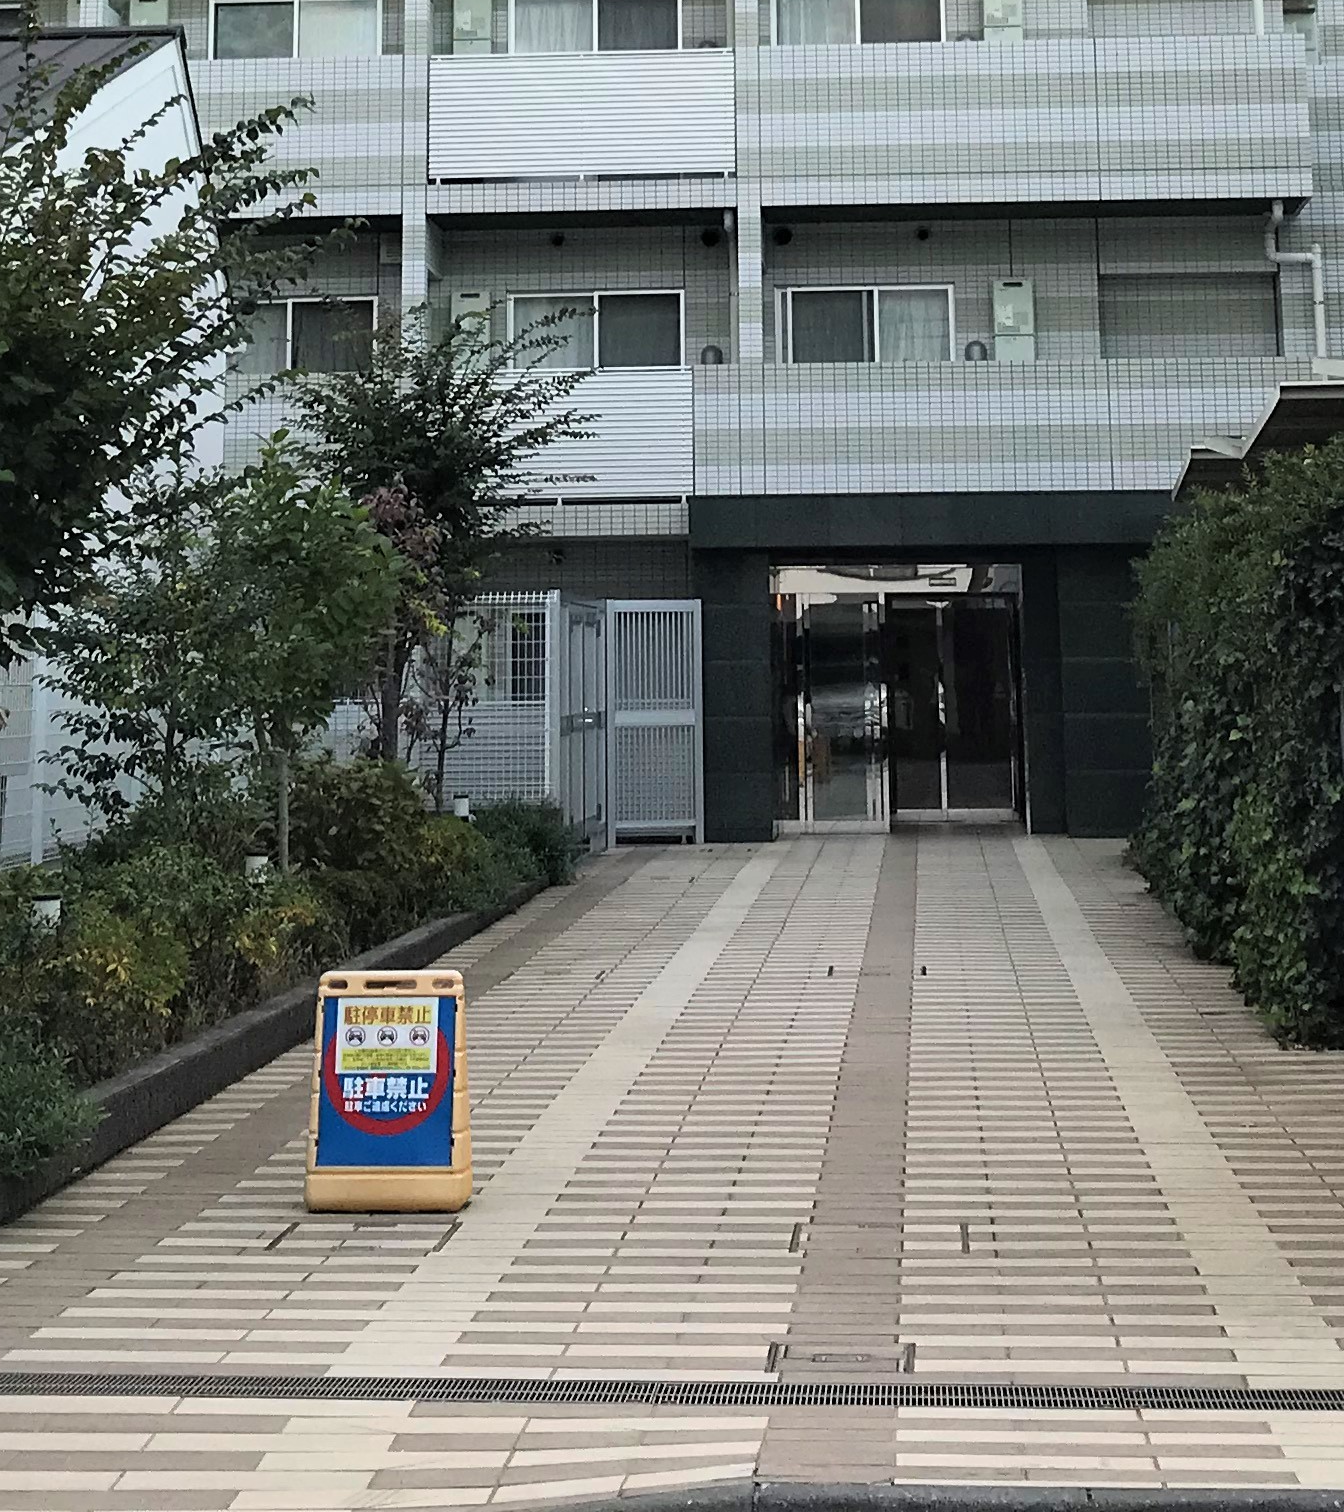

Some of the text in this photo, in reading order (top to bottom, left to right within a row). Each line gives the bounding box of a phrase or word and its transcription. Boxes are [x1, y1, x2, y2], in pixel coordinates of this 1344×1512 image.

[344, 1005, 431, 1025] 駐停車禁止
[343, 1077, 429, 1099] 駐車禁止
